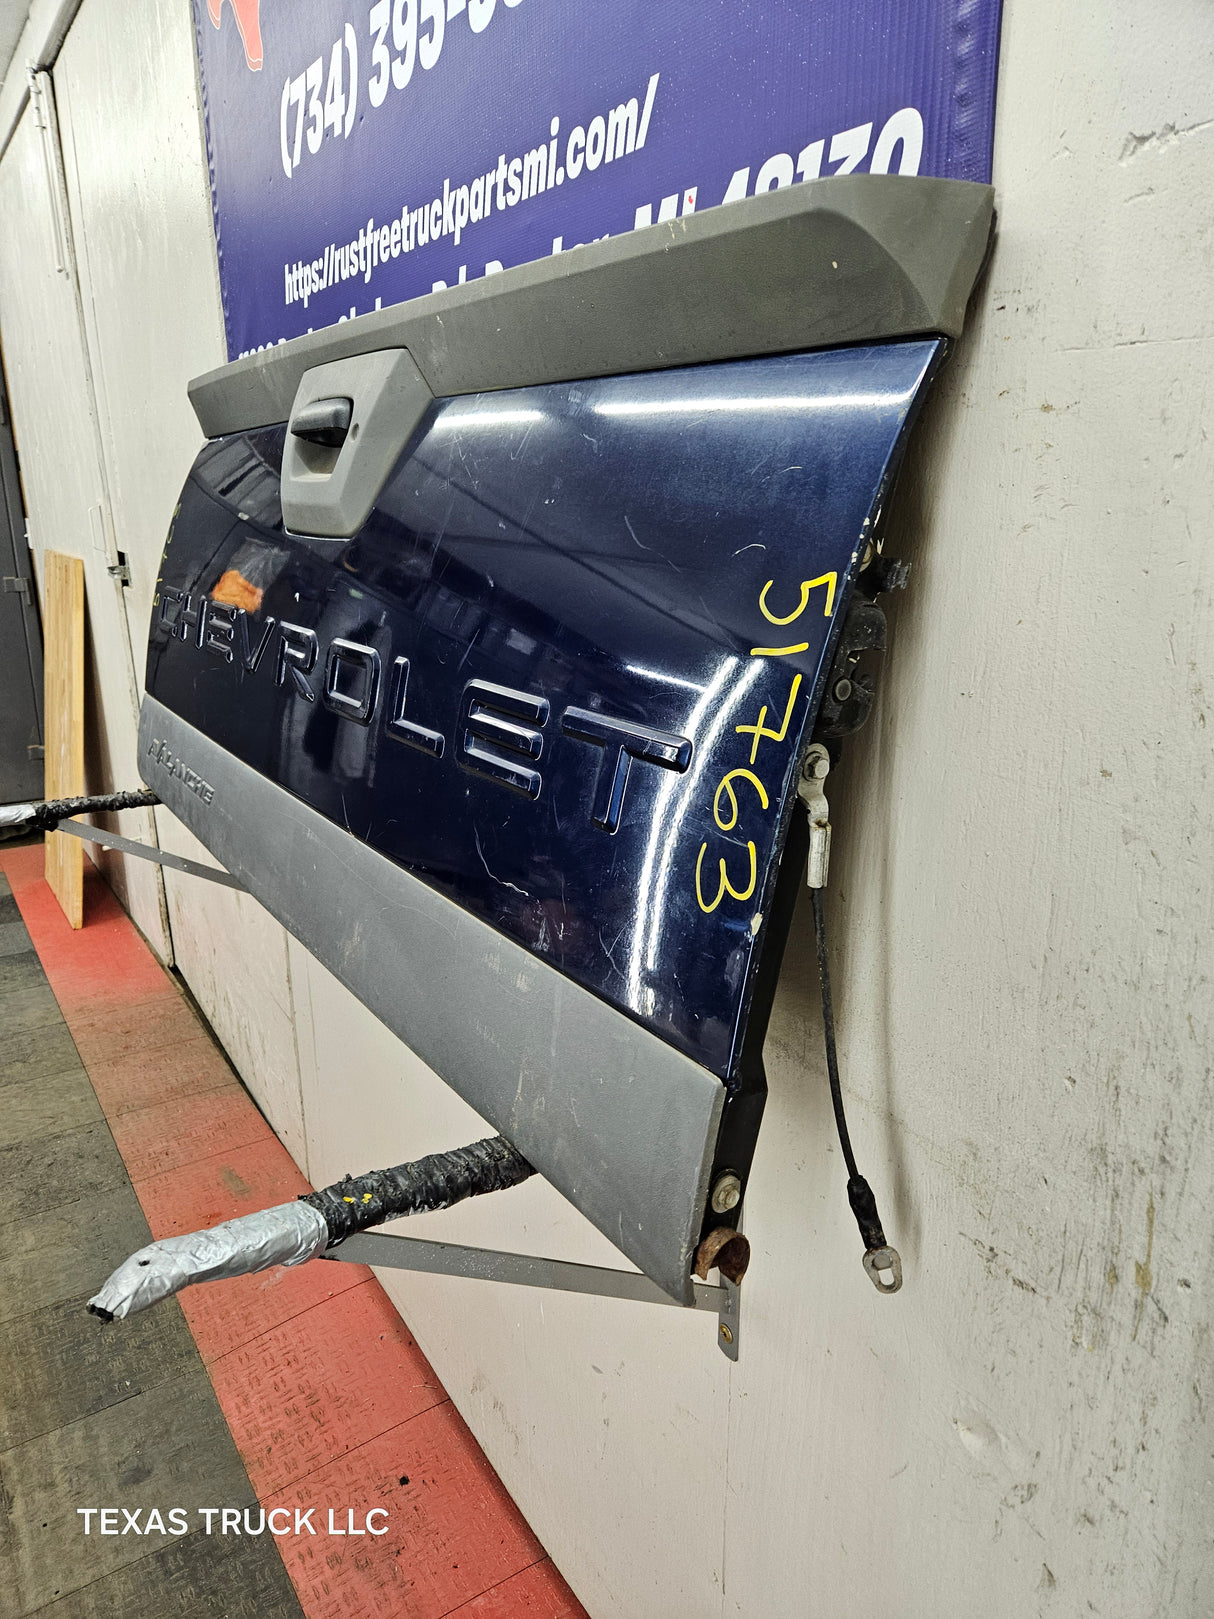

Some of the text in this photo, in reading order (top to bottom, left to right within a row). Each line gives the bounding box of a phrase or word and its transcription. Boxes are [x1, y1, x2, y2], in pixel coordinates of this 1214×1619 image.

[280, 22, 358, 179] (734)
[284, 72, 660, 308] https://rustfreetruckpartsmi.com/
[146, 738, 216, 808] AVALANCHE
[156, 584, 694, 837] CHEVROLET
[695, 571, 838, 914] 51763
